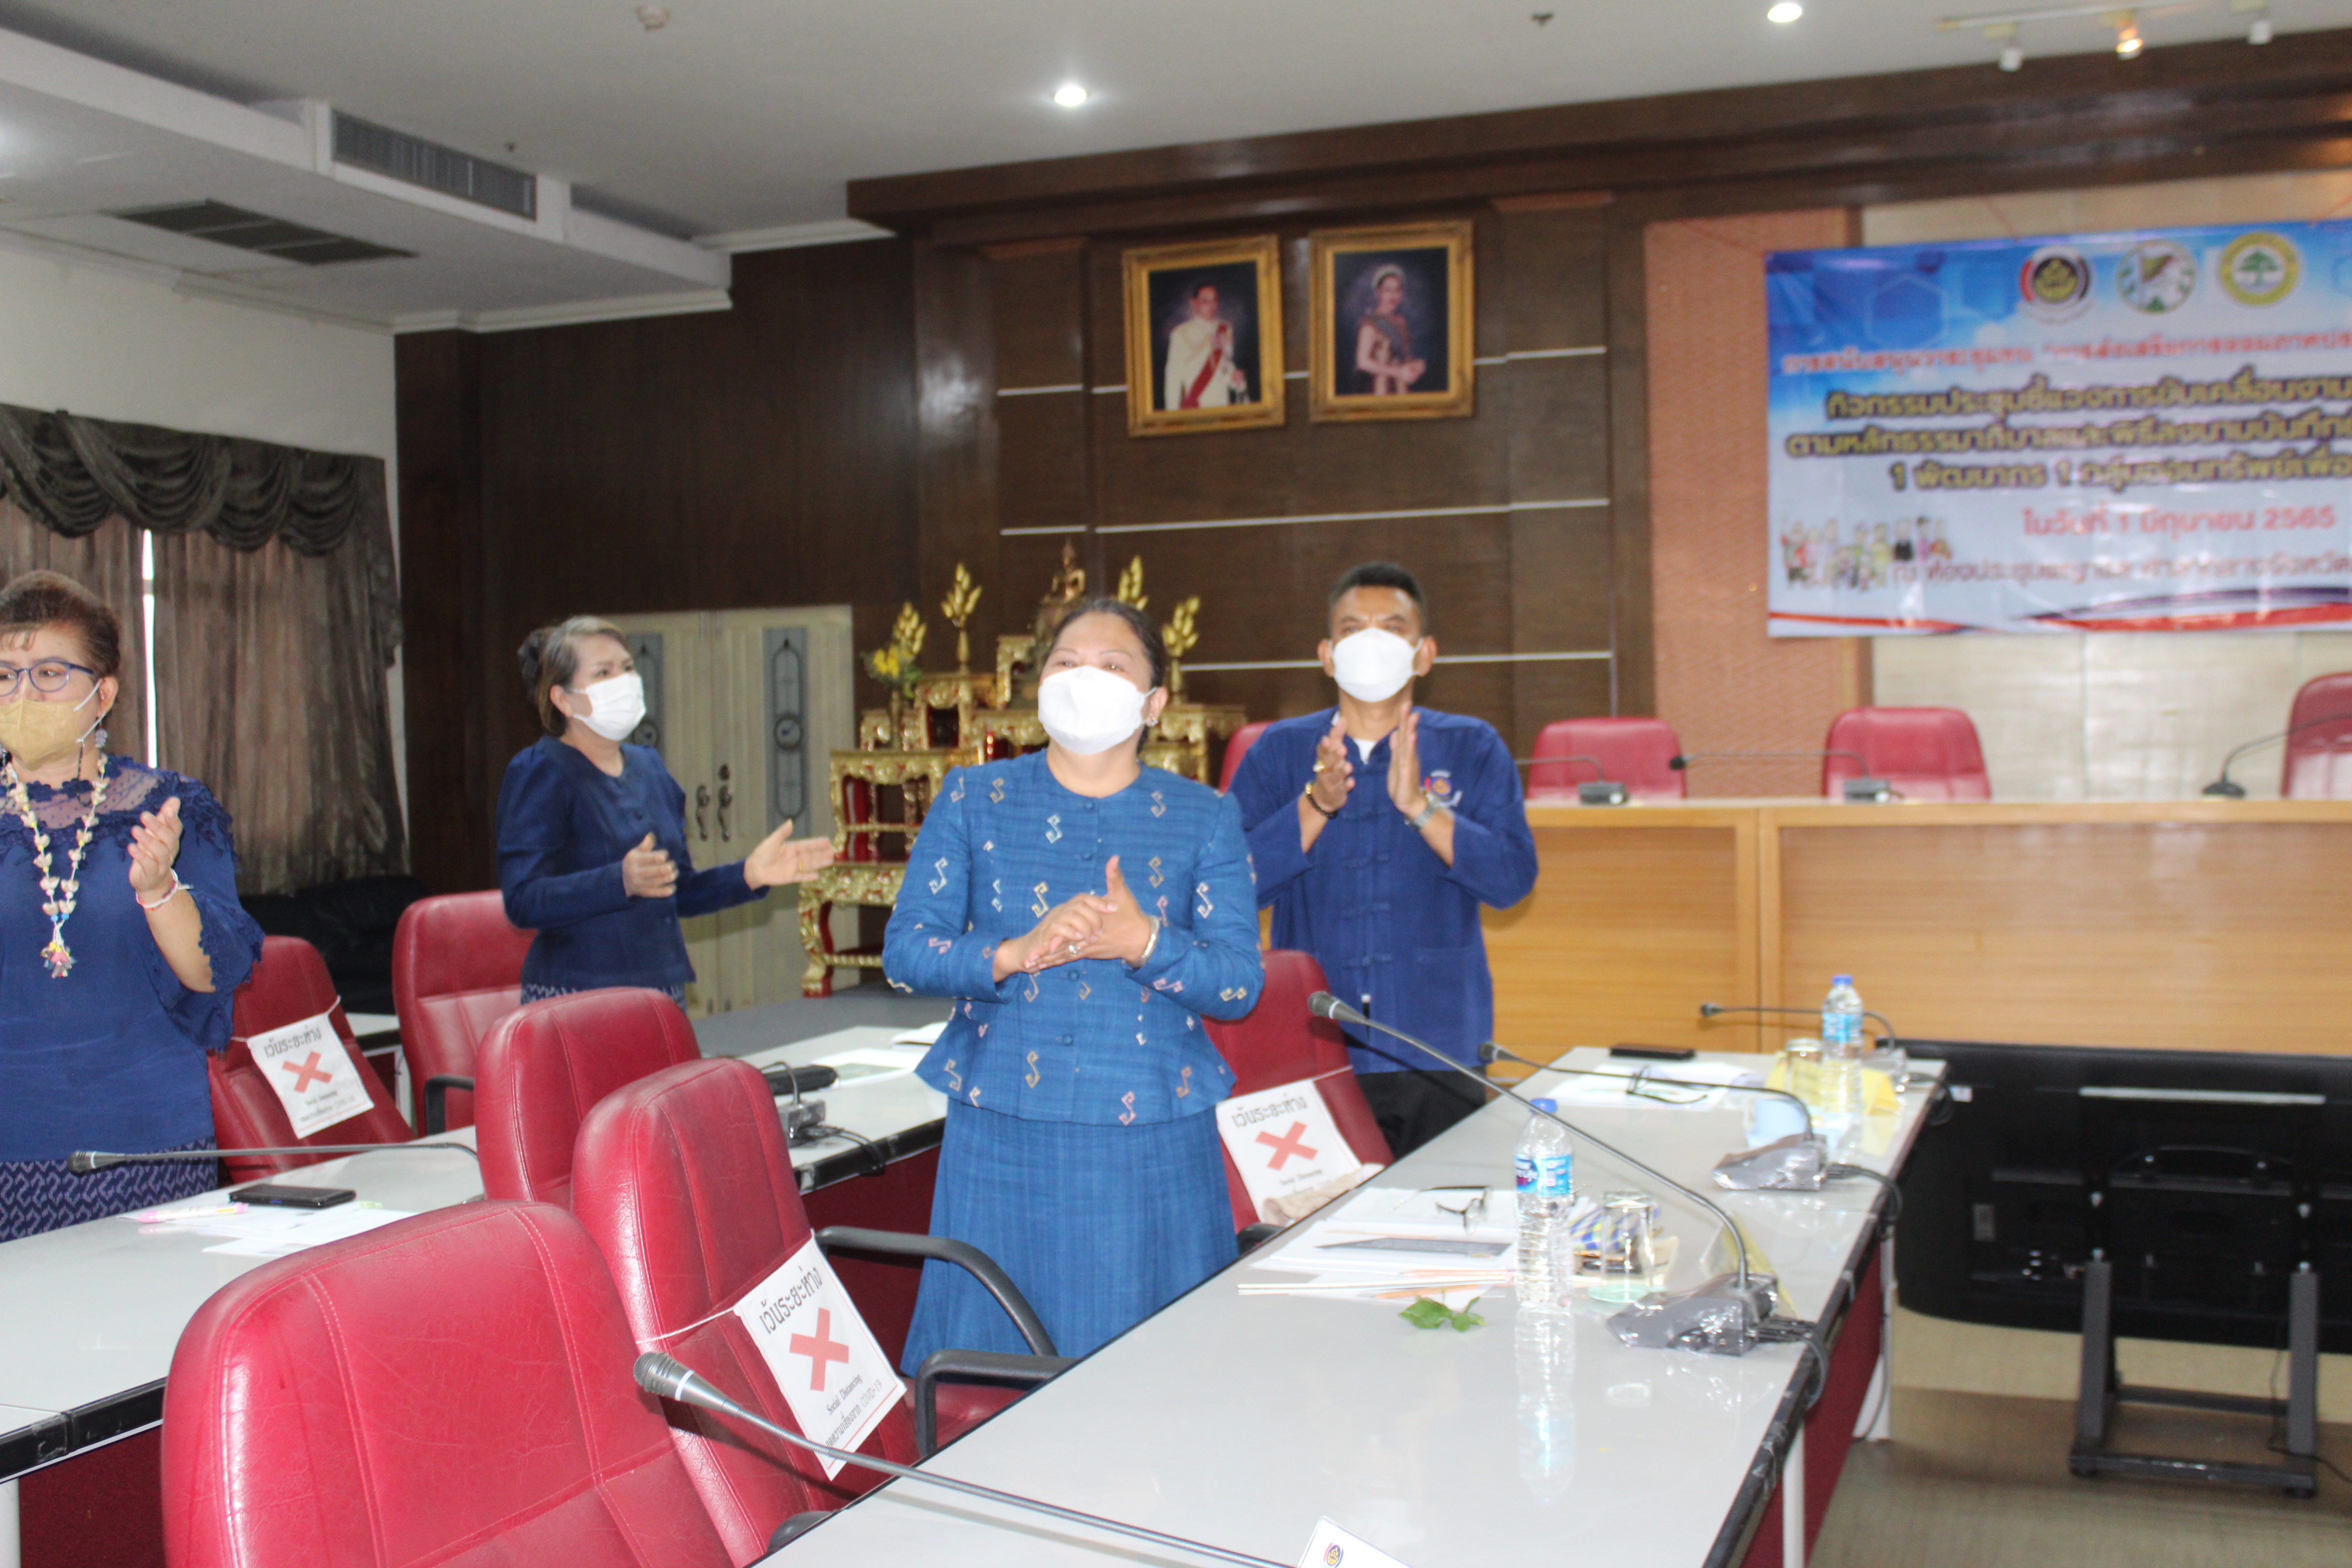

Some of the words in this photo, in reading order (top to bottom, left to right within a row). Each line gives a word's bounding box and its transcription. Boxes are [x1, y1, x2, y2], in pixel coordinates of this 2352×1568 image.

[1889, 460, 1906, 490] 1
[1913, 459, 2047, 490] พัฒนากร
[2023, 501, 2108, 535] ในวันที่
[2118, 512, 2129, 532] 1
[2140, 510, 2255, 542] มิถุนายน
[2264, 505, 2337, 531] 2565
[264, 1025, 322, 1058] เว้นระยะห่าง
[1232, 1093, 1308, 1128] เว้นระยะห่าง
[759, 1265, 823, 1334] เว้นระยะห่าง
[826, 1395, 841, 1415] Social
[839, 1374, 862, 1400] Distancing
[861, 1380, 882, 1407] COVID-19
